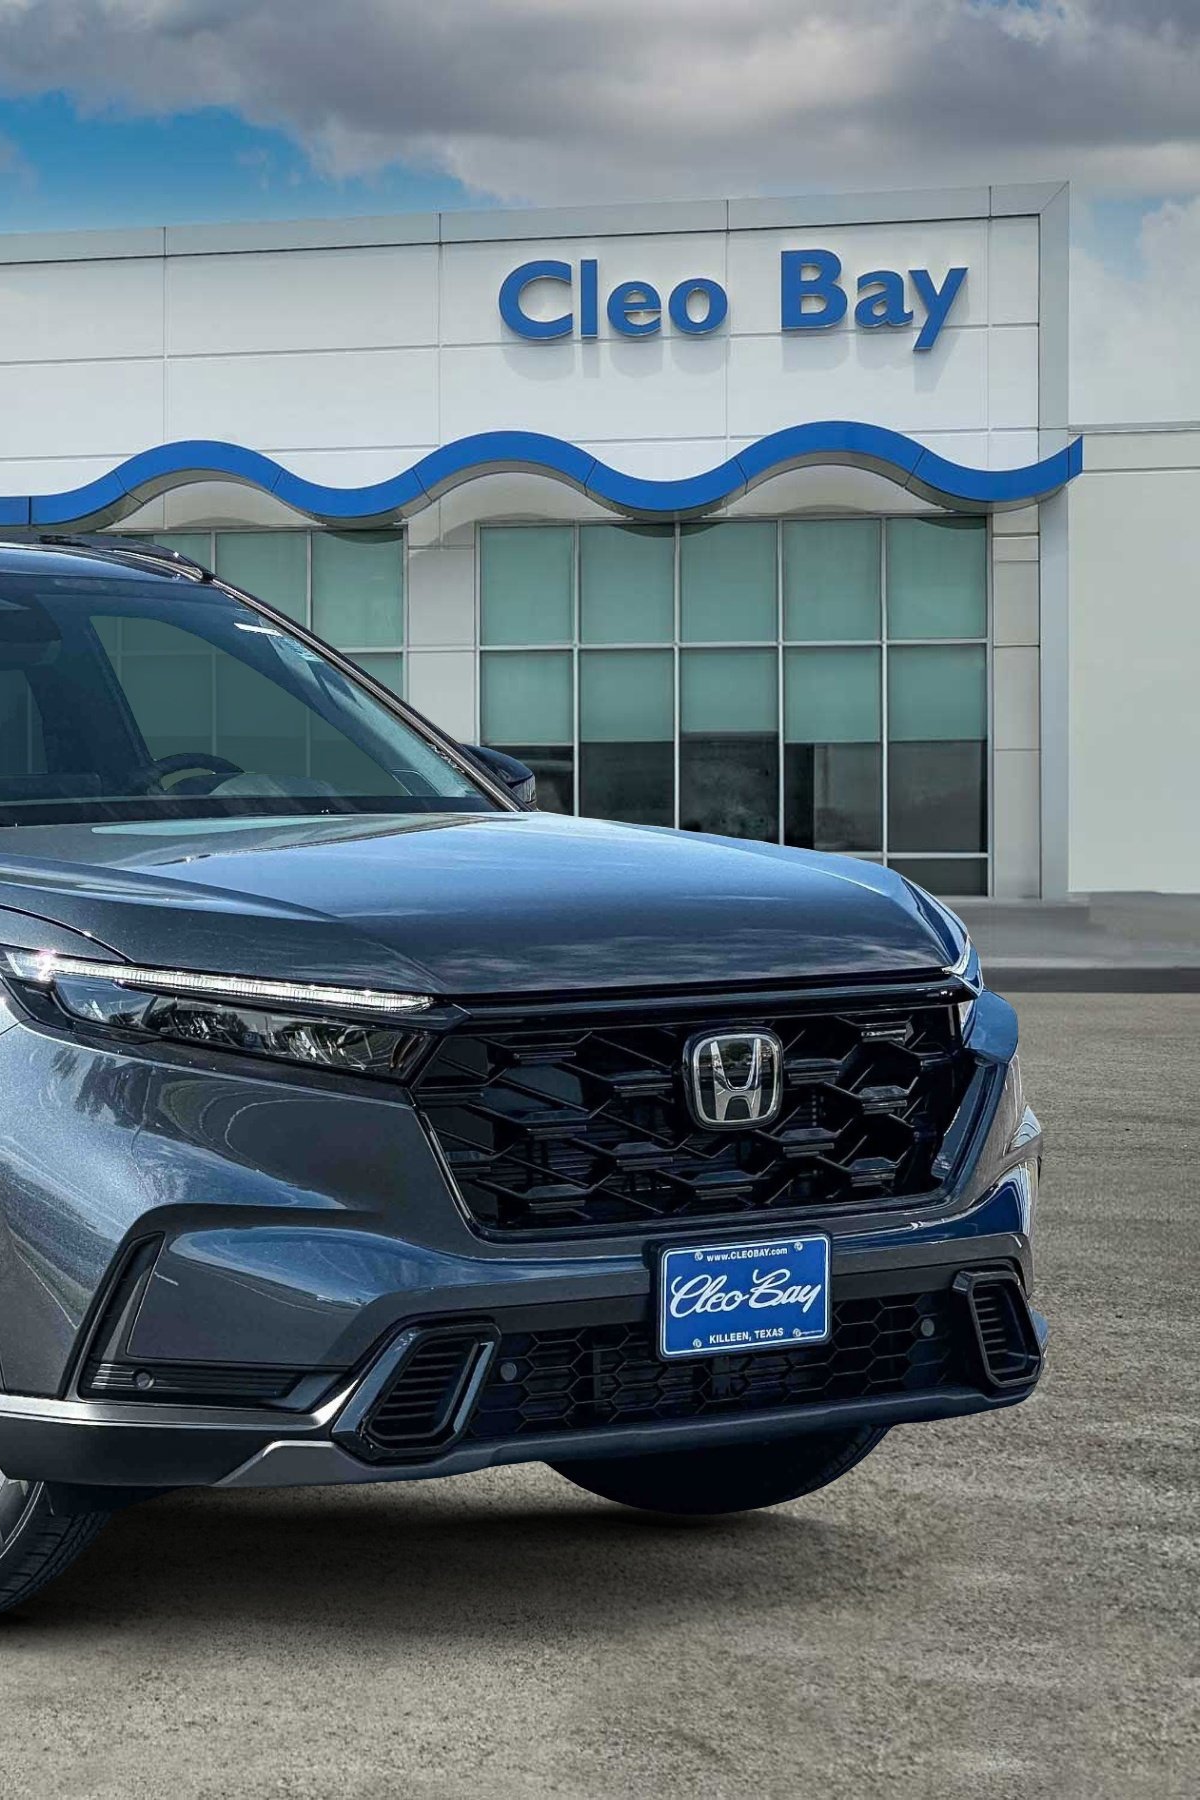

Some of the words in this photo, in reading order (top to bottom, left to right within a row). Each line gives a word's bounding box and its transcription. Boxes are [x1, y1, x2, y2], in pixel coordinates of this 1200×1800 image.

[498, 258, 728, 341] Cleo
[780, 248, 969, 351] Bay
[706, 1247, 788, 1262] www.CLEOBAY.com
[669, 1273, 750, 1319] Cleo
[748, 1268, 822, 1314] Bay
[709, 1330, 752, 1345] KILLEEN,
[754, 1327, 784, 1340] TEXAS
